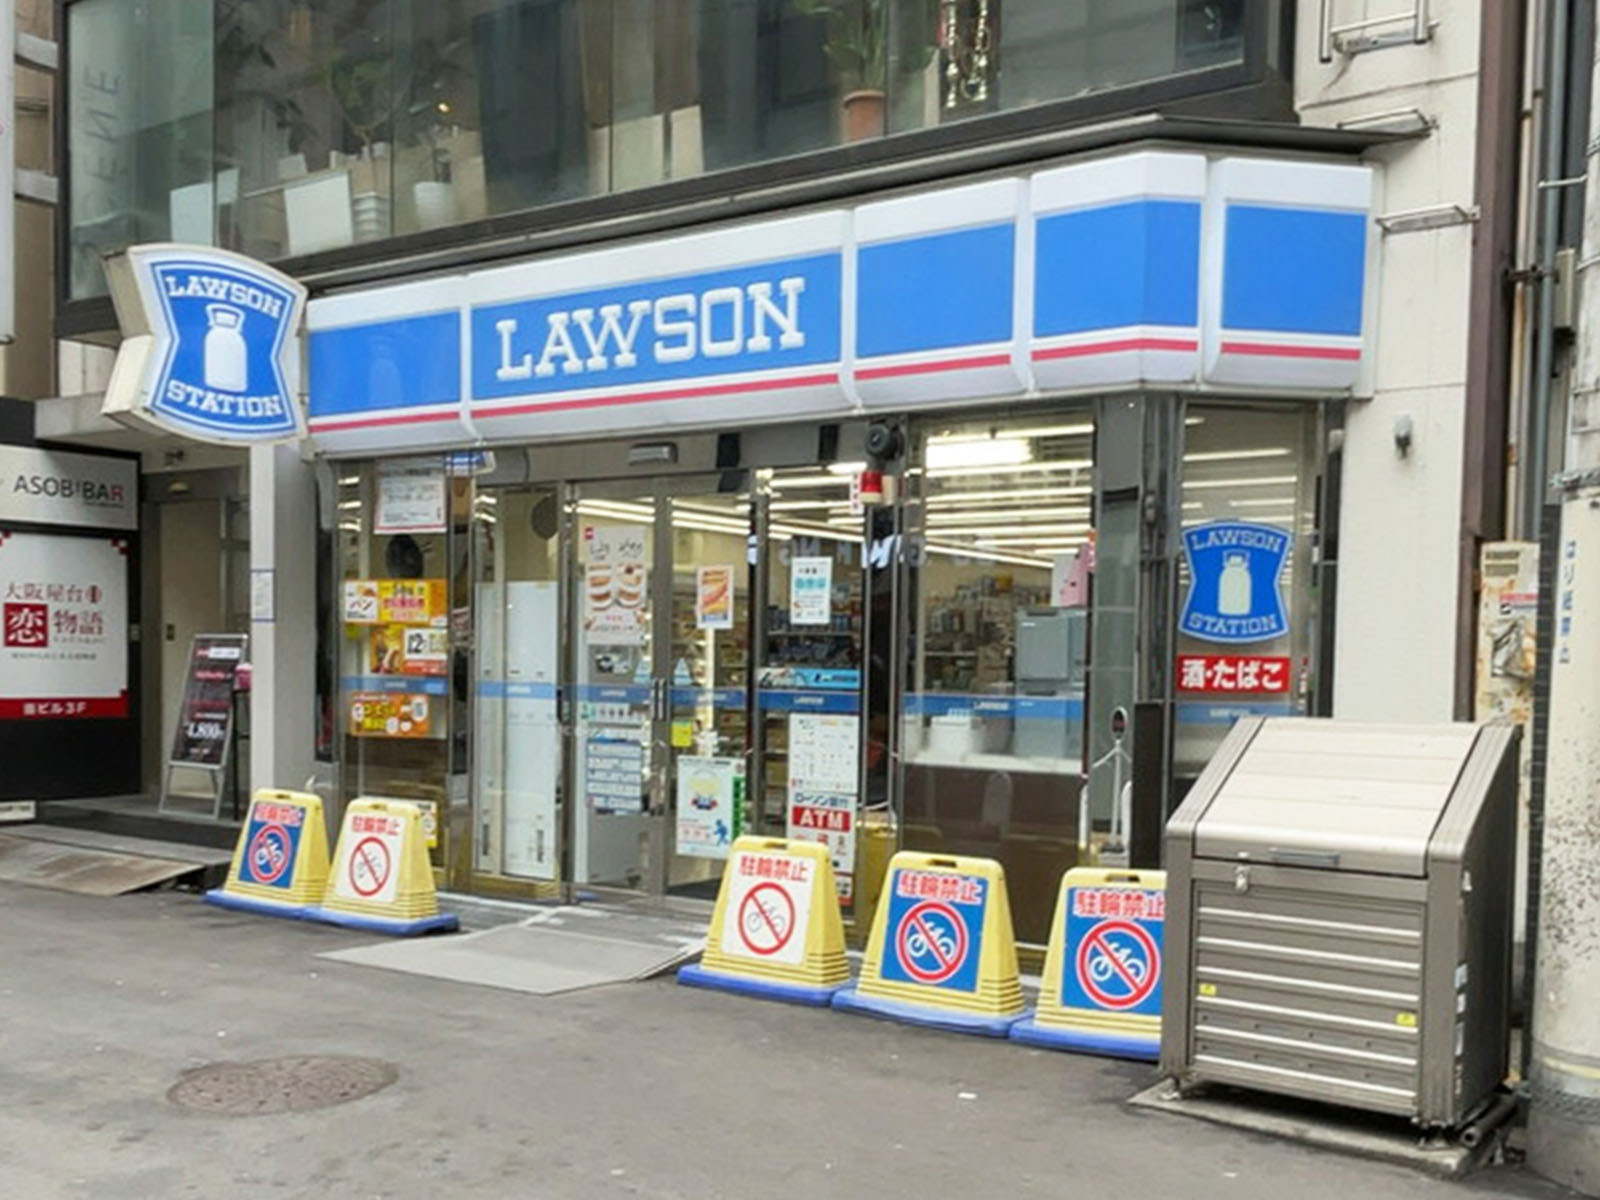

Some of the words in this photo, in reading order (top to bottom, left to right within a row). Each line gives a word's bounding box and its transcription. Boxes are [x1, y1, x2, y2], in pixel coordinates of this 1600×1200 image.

[165, 275, 282, 319] LAWSON
[496, 277, 806, 381] LAWSON
[166, 380, 283, 418] STATION
[1191, 529, 1283, 553] LAWSON
[1187, 613, 1277, 636] STATION
[254, 802, 305, 828] 駐輪禁止
[351, 815, 399, 836] 駐輪禁止
[799, 809, 844, 831] ATM
[740, 855, 809, 883] 駐輪禁止
[898, 872, 983, 905] 駐輪禁止
[1073, 888, 1166, 920] 駐輪禁止
